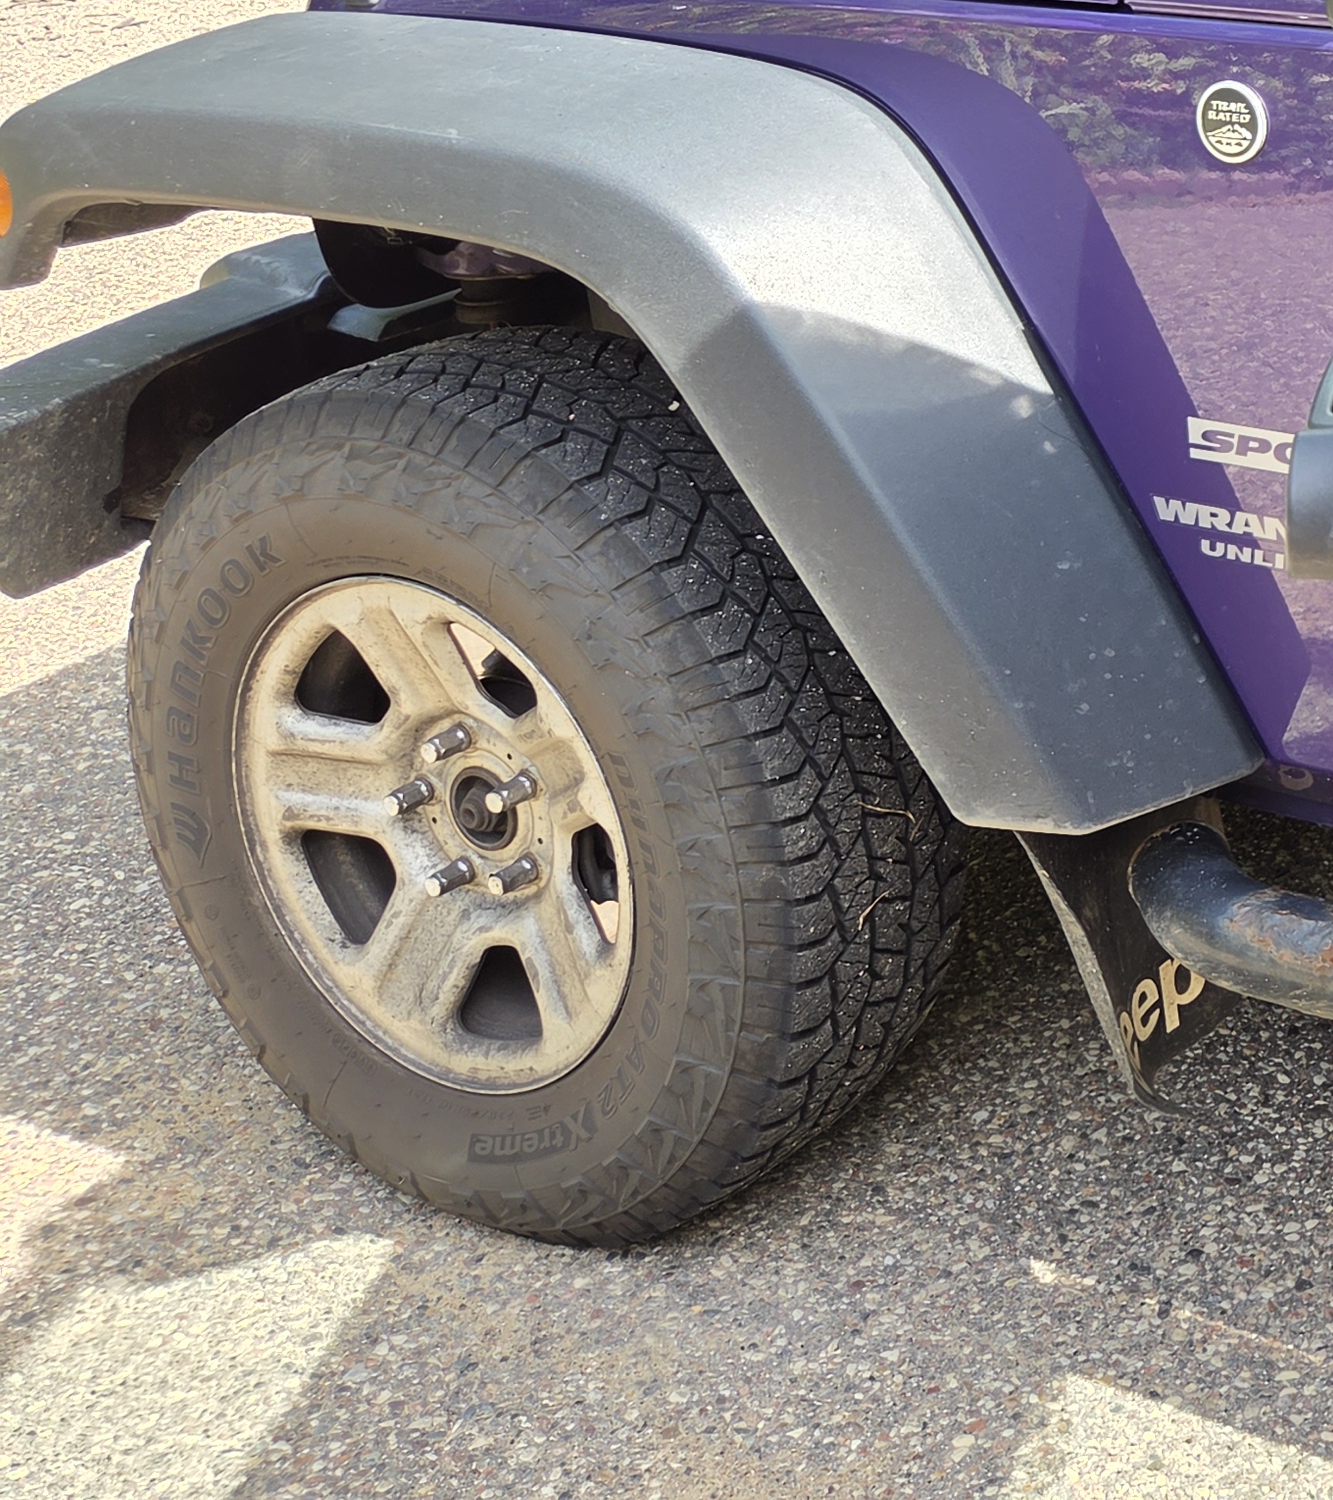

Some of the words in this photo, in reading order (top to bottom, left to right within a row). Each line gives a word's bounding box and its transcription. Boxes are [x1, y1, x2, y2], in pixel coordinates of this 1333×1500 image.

[1208, 110, 1252, 123] RATED
[1210, 100, 1250, 113] TRAIL
[1120, 958, 1206, 1096] eep
[474, 1104, 594, 1156] Xtreme
